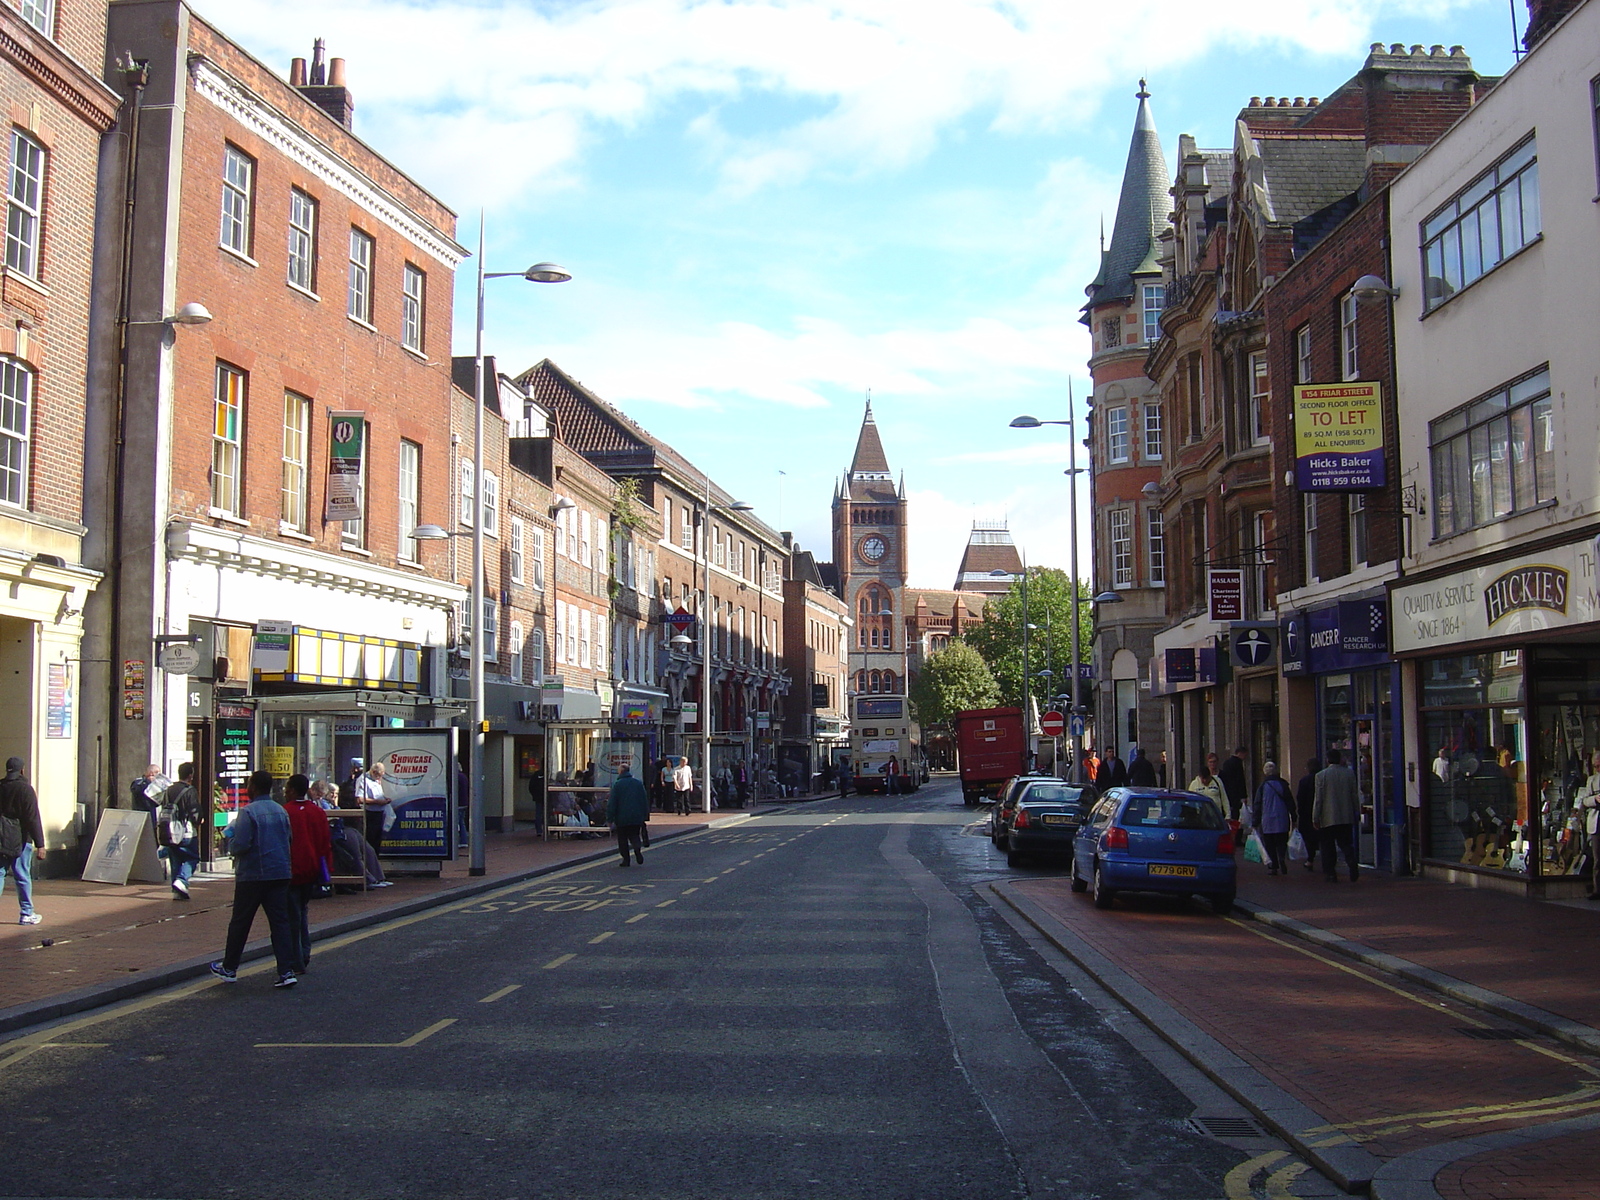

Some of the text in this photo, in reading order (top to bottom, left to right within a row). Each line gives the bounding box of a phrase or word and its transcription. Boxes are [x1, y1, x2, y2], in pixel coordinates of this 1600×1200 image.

[1310, 410, 1367, 426] TO LET
[1335, 429, 1351, 437] (958
[1330, 438, 1365, 446] ENQUIRIES
[1310, 457, 1371, 468] Hicks Baker
[1312, 476, 1371, 486] 0118 959 6144
[1403, 583, 1475, 620] QUALITY & SERVICE
[1487, 572, 1565, 622] HICKIES
[1418, 616, 1459, 640] SINCE 1864
[1310, 629, 1334, 649] CANCER
[190, 692, 200, 707] 15
[390, 754, 432, 763] SHOWCASE
[393, 763, 428, 773] CINEMAS
[1150, 866, 1195, 876] X779 GRV
[524, 885, 655, 897] BUS
[460, 899, 639, 914] STOP
